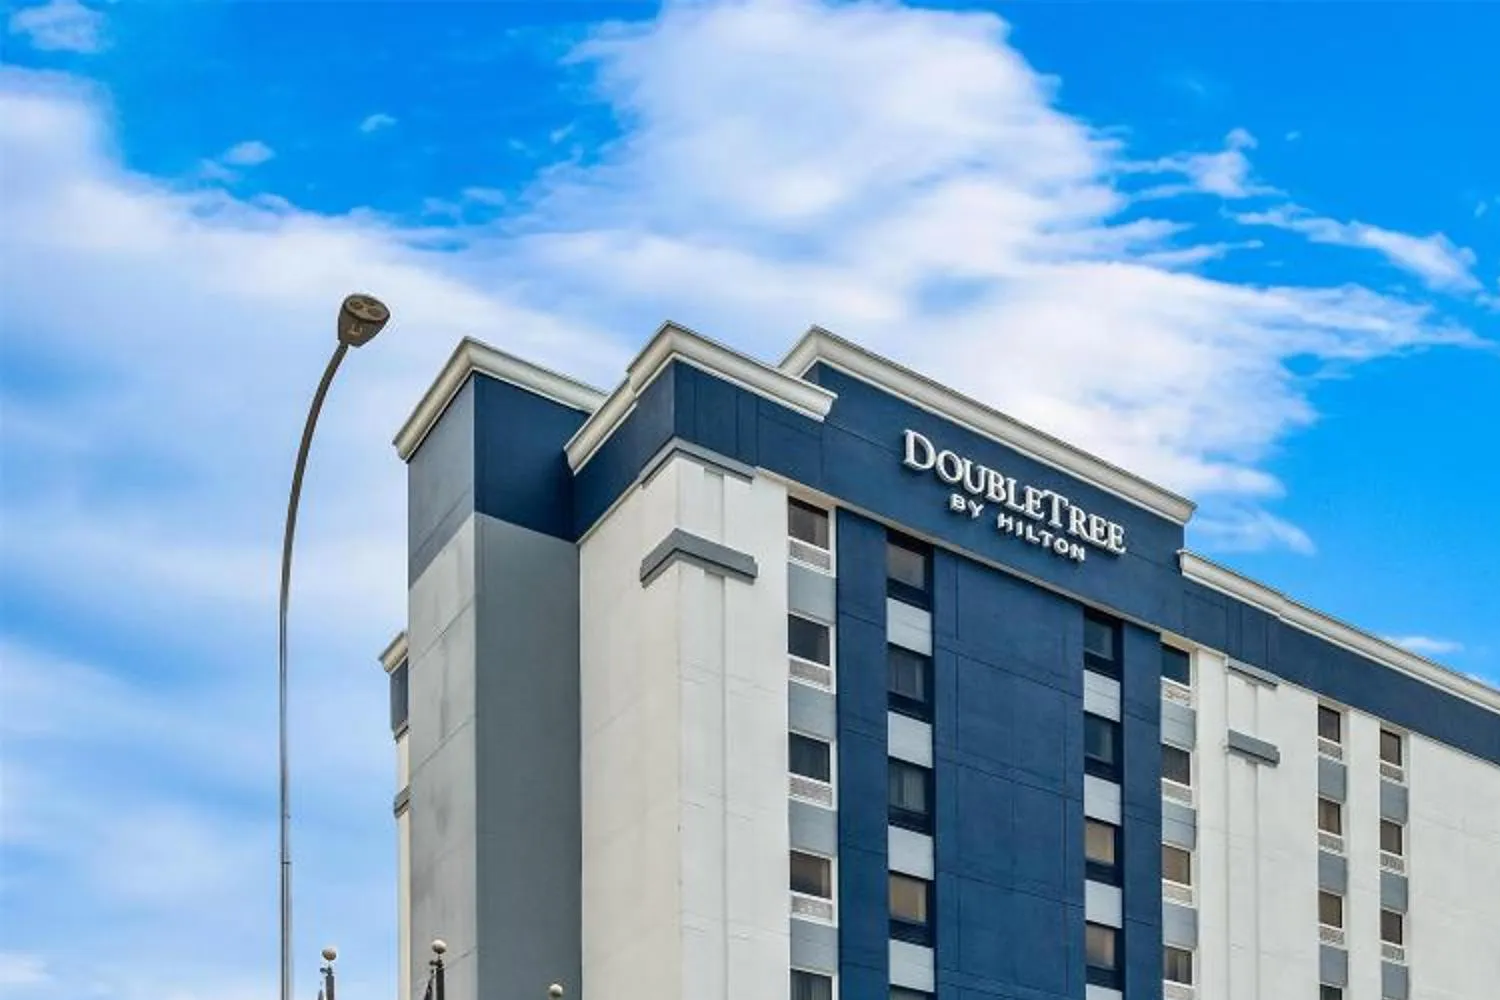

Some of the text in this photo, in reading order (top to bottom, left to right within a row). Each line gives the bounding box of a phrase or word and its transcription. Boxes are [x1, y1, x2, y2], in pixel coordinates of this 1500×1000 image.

[903, 428, 1127, 555] DOUBLETREE
[949, 493, 1086, 563] BY HILTON
